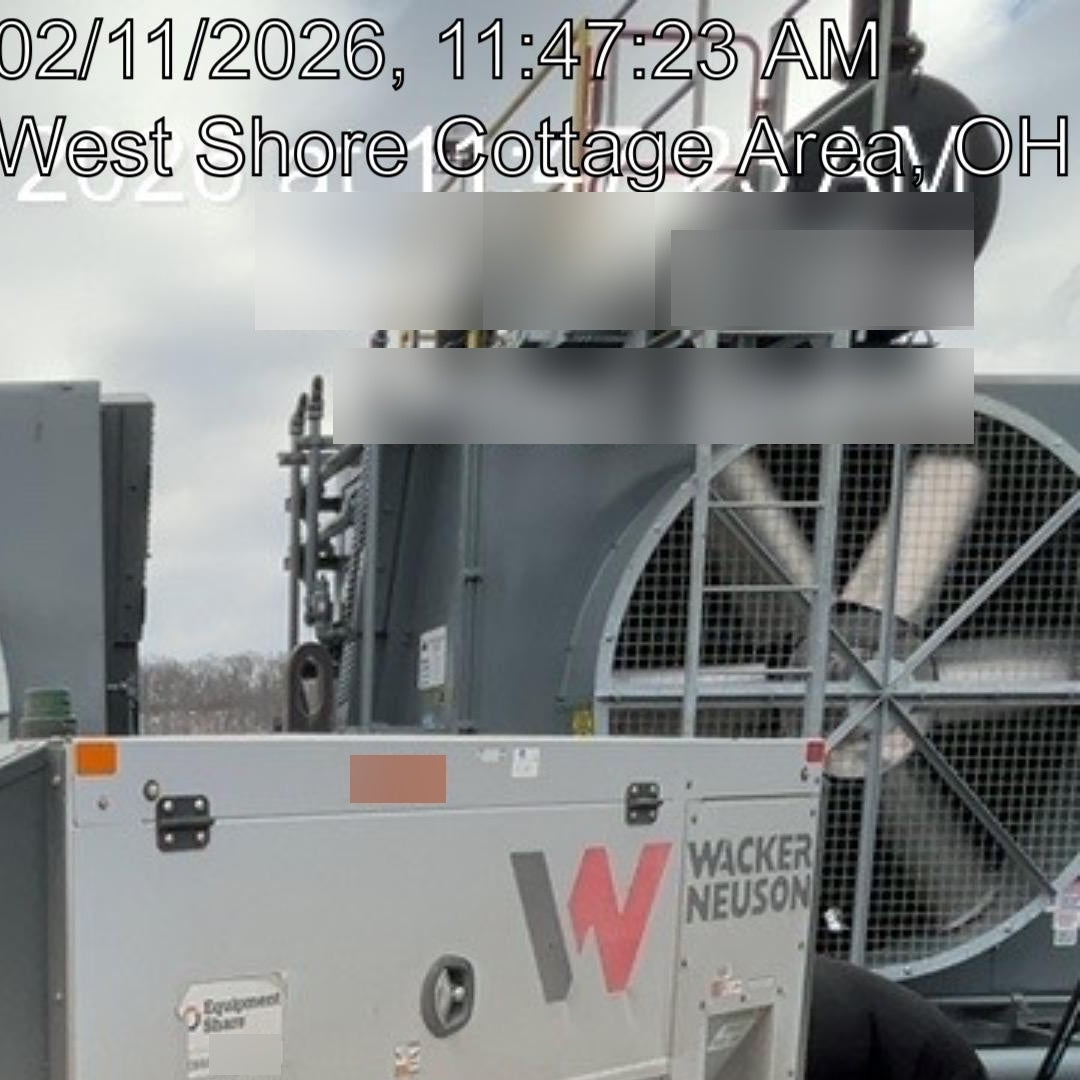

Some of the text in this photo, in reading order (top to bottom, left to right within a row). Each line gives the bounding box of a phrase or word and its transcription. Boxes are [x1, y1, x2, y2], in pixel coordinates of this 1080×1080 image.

[687, 833, 812, 880] WACKER
[686, 875, 811, 924] NEUSON
[203, 992, 280, 1017] Equipment
[203, 1016, 246, 1033] Share
